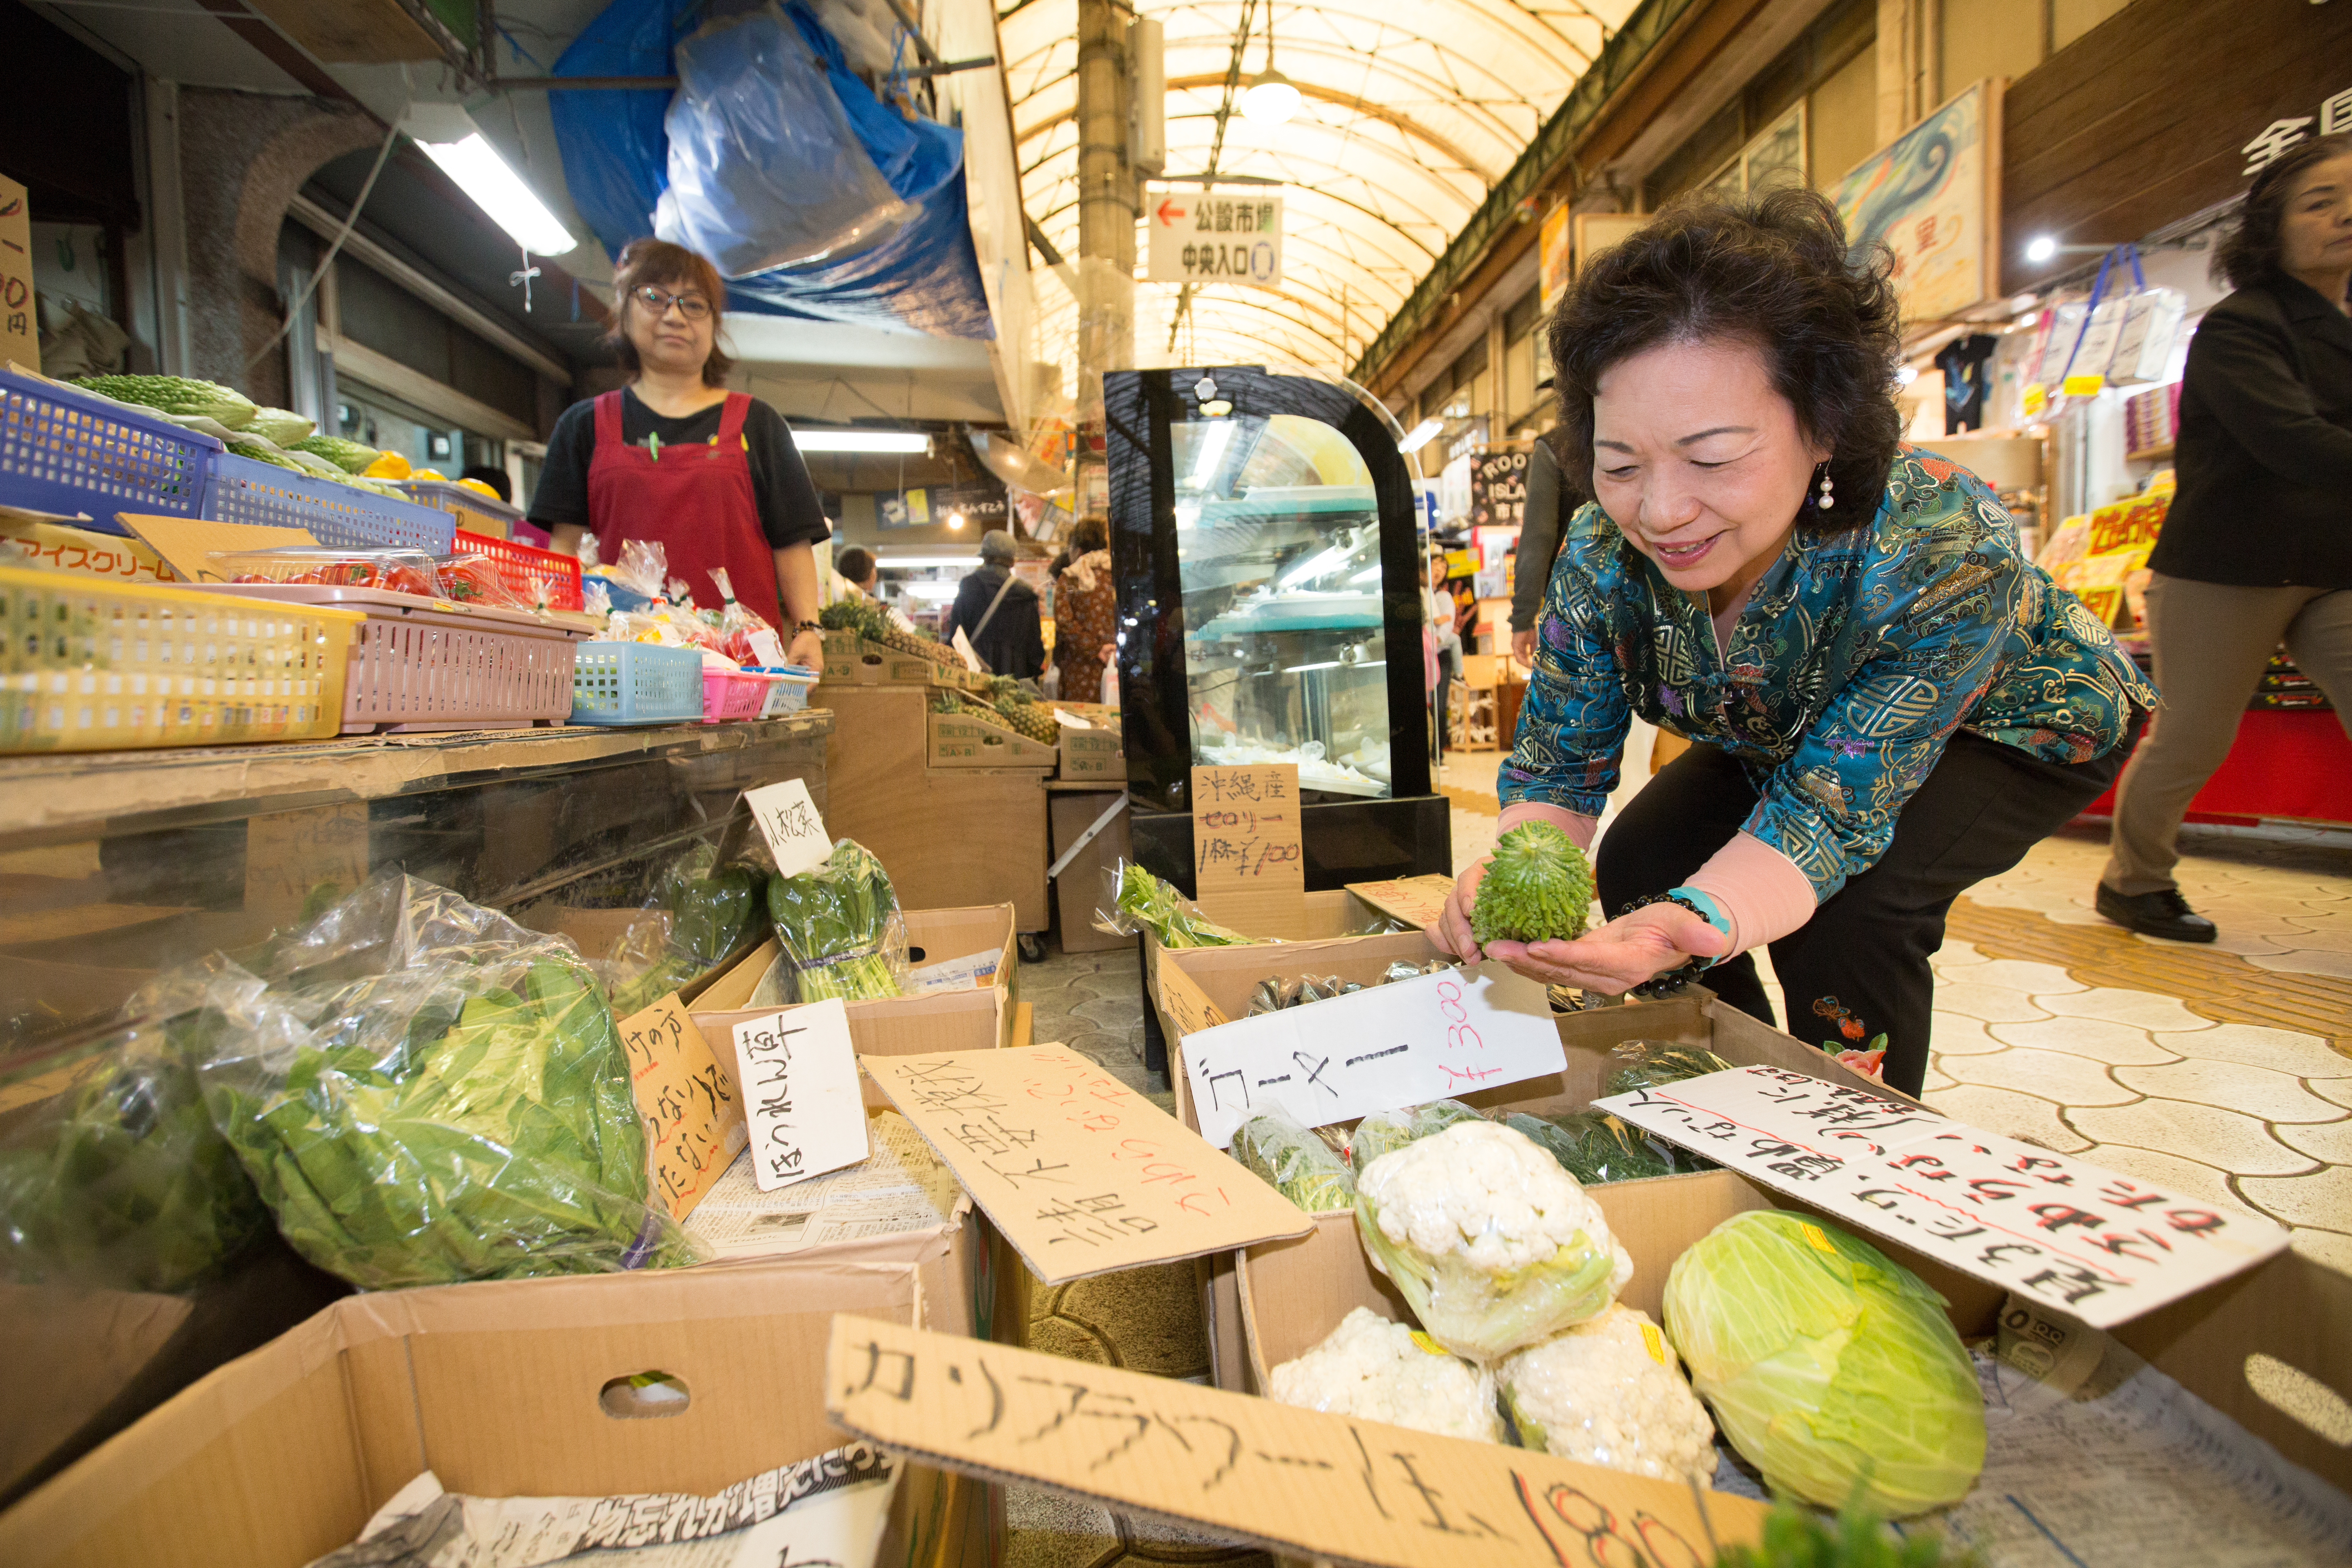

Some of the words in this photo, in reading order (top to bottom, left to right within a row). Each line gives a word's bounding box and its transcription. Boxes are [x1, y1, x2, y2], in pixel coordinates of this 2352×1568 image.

[1195, 200, 1274, 233] 公設市場
[1182, 241, 1248, 275] 中央入口
[7, 311, 27, 336] 円
[1483, 453, 1526, 480] ROO
[1488, 482, 1527, 500] ISLA
[15, 537, 176, 583] アイスクリーム
[1198, 770, 1285, 802] 沖縄産
[762, 800, 820, 849] 小松菜
[1198, 810, 1283, 833] セロリー
[625, 1009, 682, 1065] けの方
[742, 1014, 808, 1178] ほうれん草
[1199, 1044, 1409, 1112] ゴーヤー
[658, 1123, 713, 1209] たない
[894, 1060, 1159, 1247] 請不要摸我
[1023, 1077, 1231, 1217] さわらないで
[1831, 1131, 2172, 1265] さわらない
[1934, 1133, 2228, 1238] もたない
[844, 1340, 1334, 1490] カリフラワー
